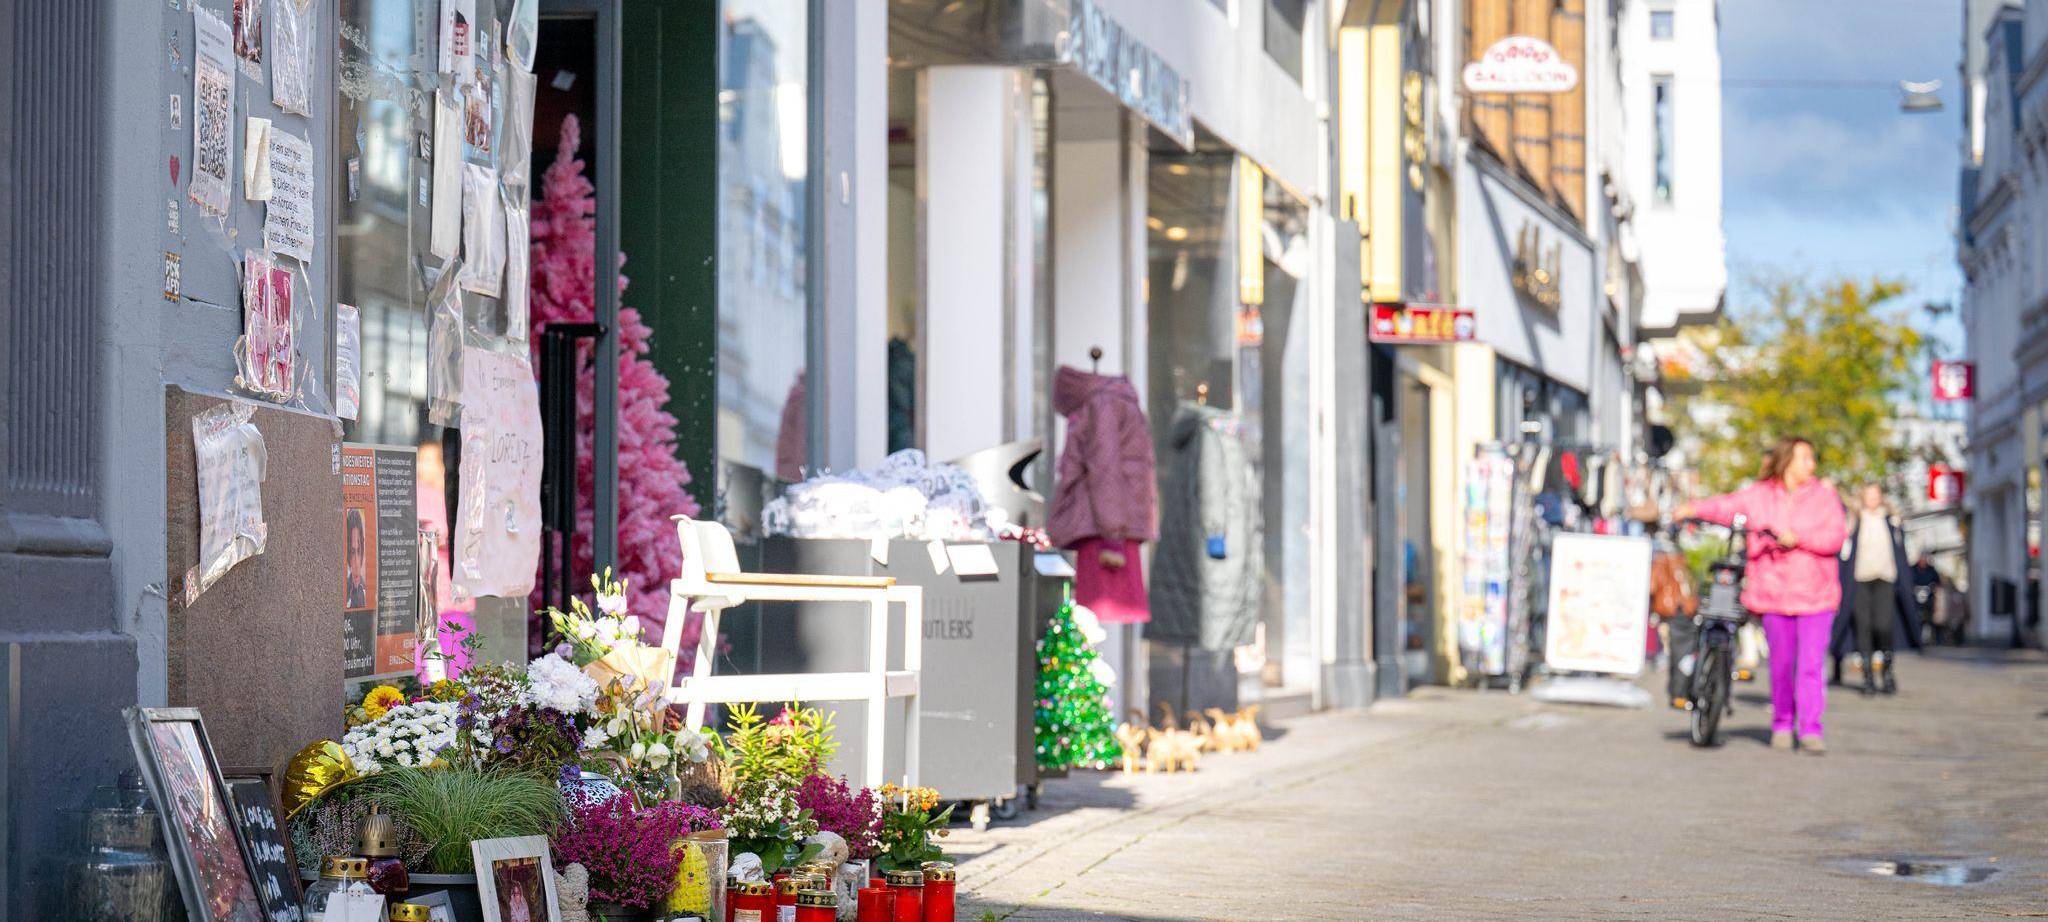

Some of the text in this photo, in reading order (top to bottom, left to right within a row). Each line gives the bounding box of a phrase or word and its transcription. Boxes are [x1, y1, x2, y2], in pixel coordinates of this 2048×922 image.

[343, 455, 374, 468] NDESWEITER
[343, 473, 370, 486] KTIONSTAG
[923, 618, 974, 641] UTLERS
[344, 654, 373, 670] hausmarkt
